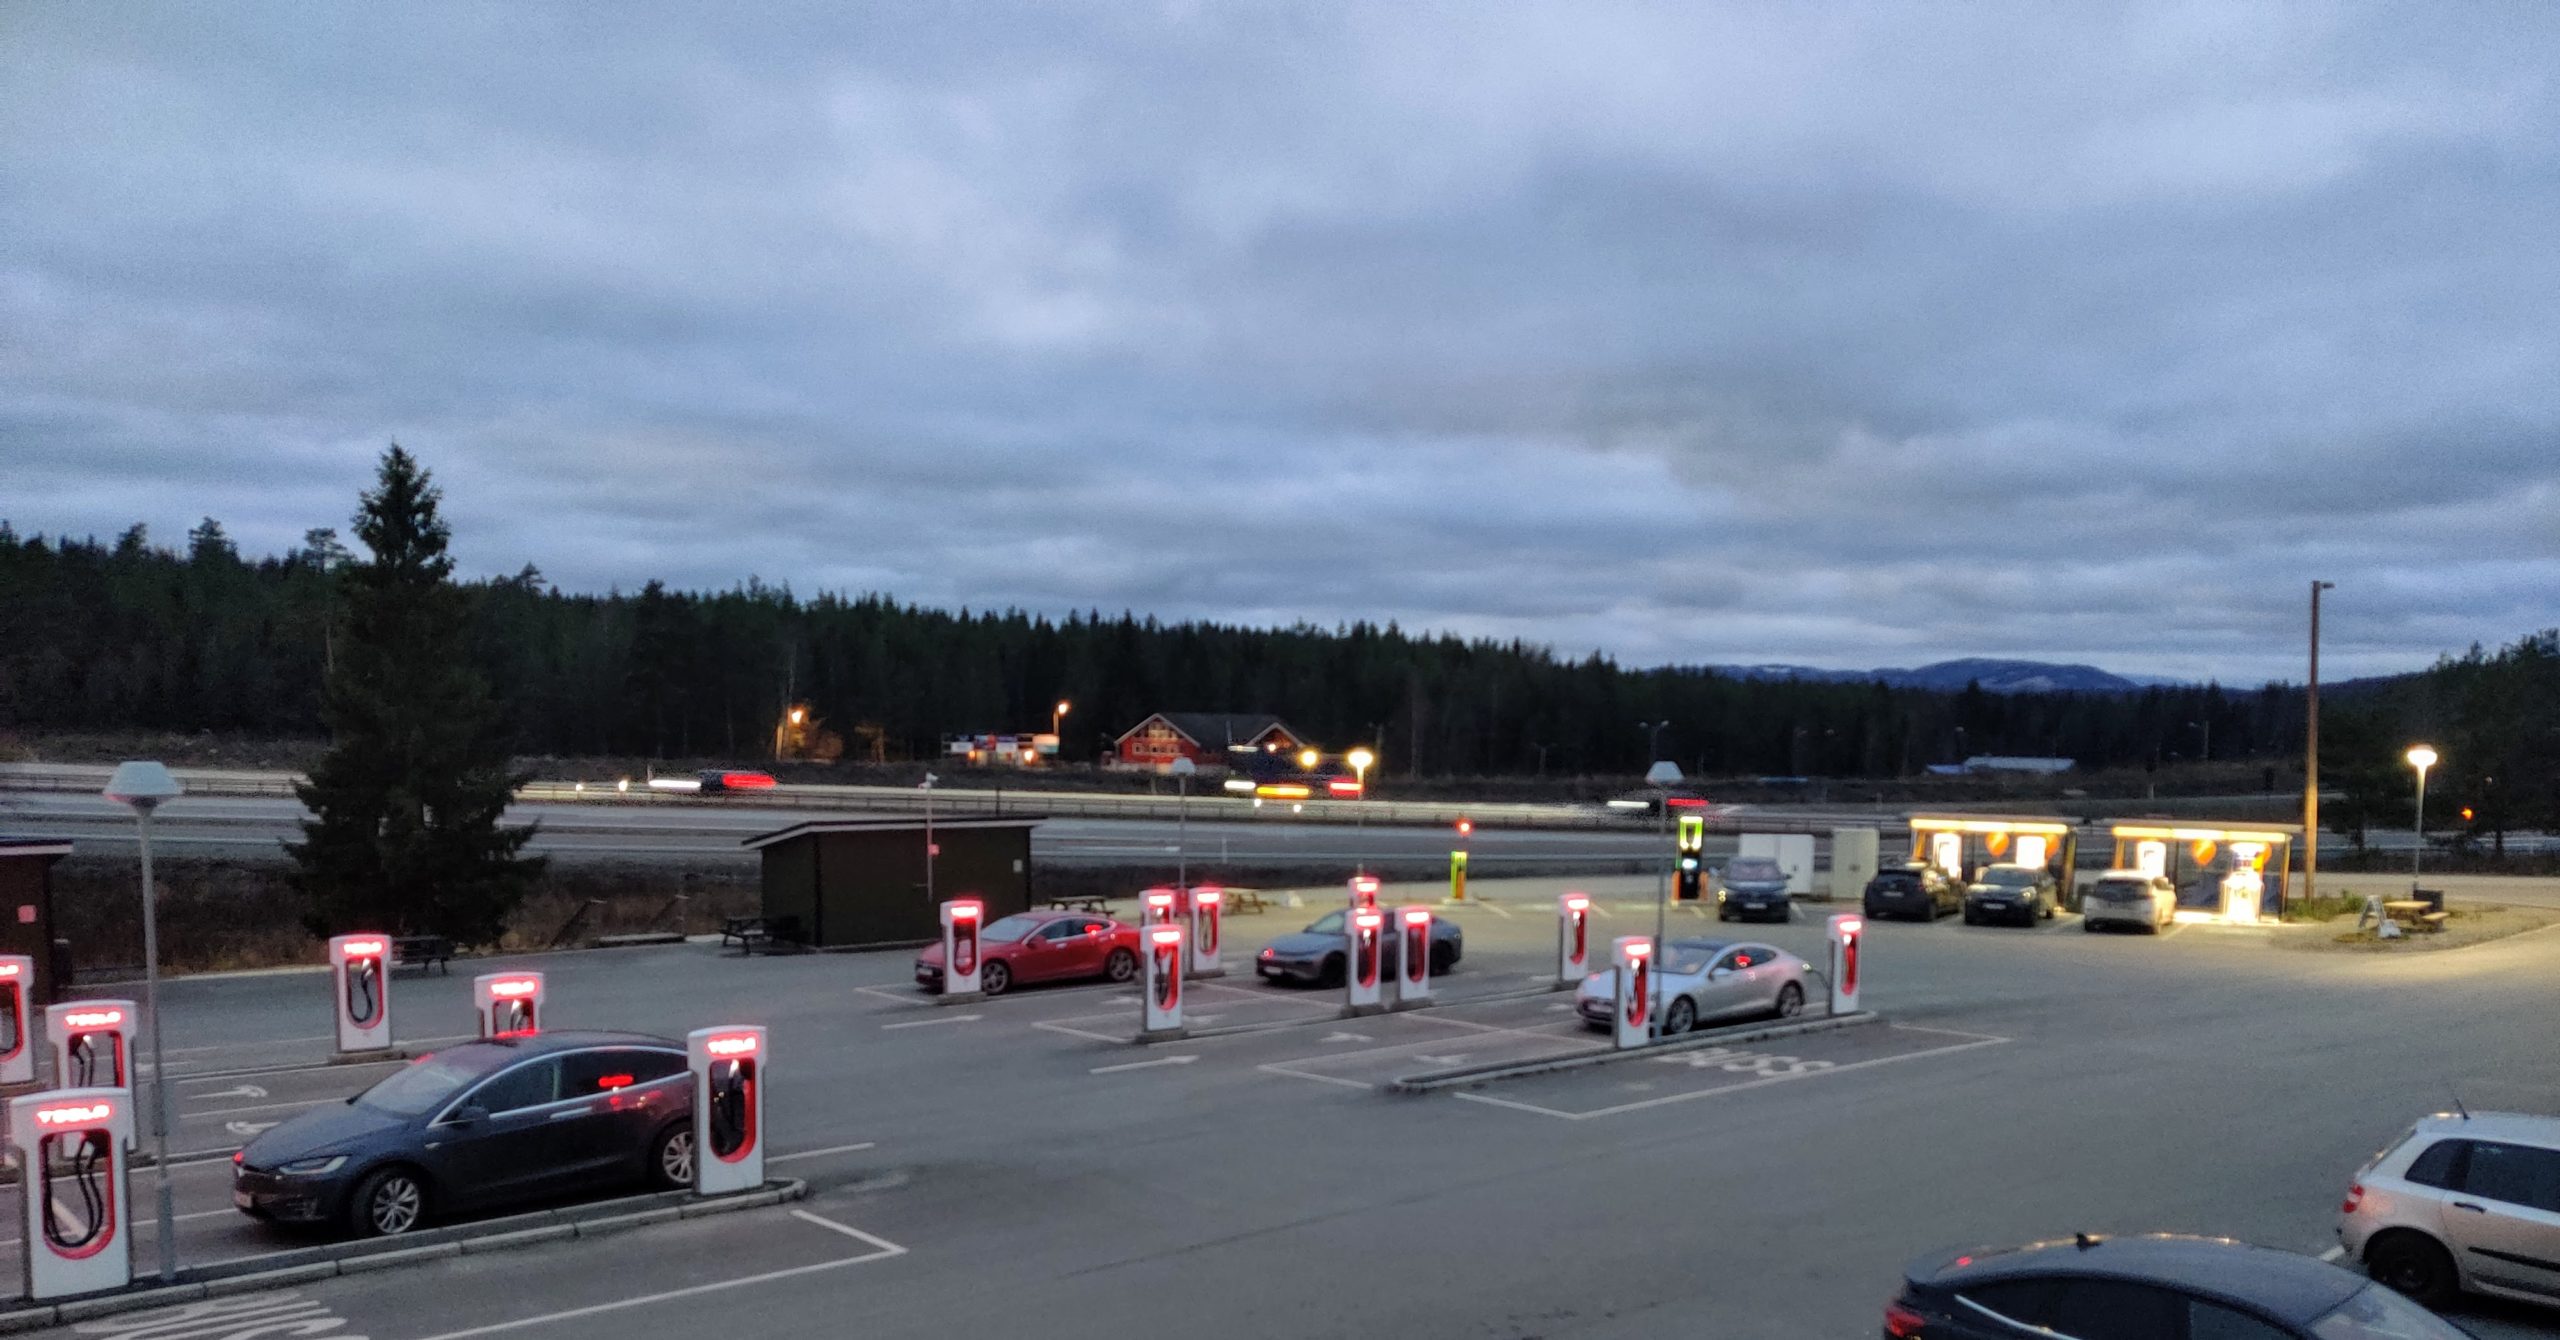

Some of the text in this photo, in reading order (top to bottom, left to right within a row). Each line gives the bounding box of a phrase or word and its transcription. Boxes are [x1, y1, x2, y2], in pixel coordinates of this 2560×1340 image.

[65, 1011, 121, 1027] TESLA
[707, 1036, 757, 1055] TESLA
[36, 1104, 110, 1124] TESLA
[72, 1286, 369, 1340] BUS
